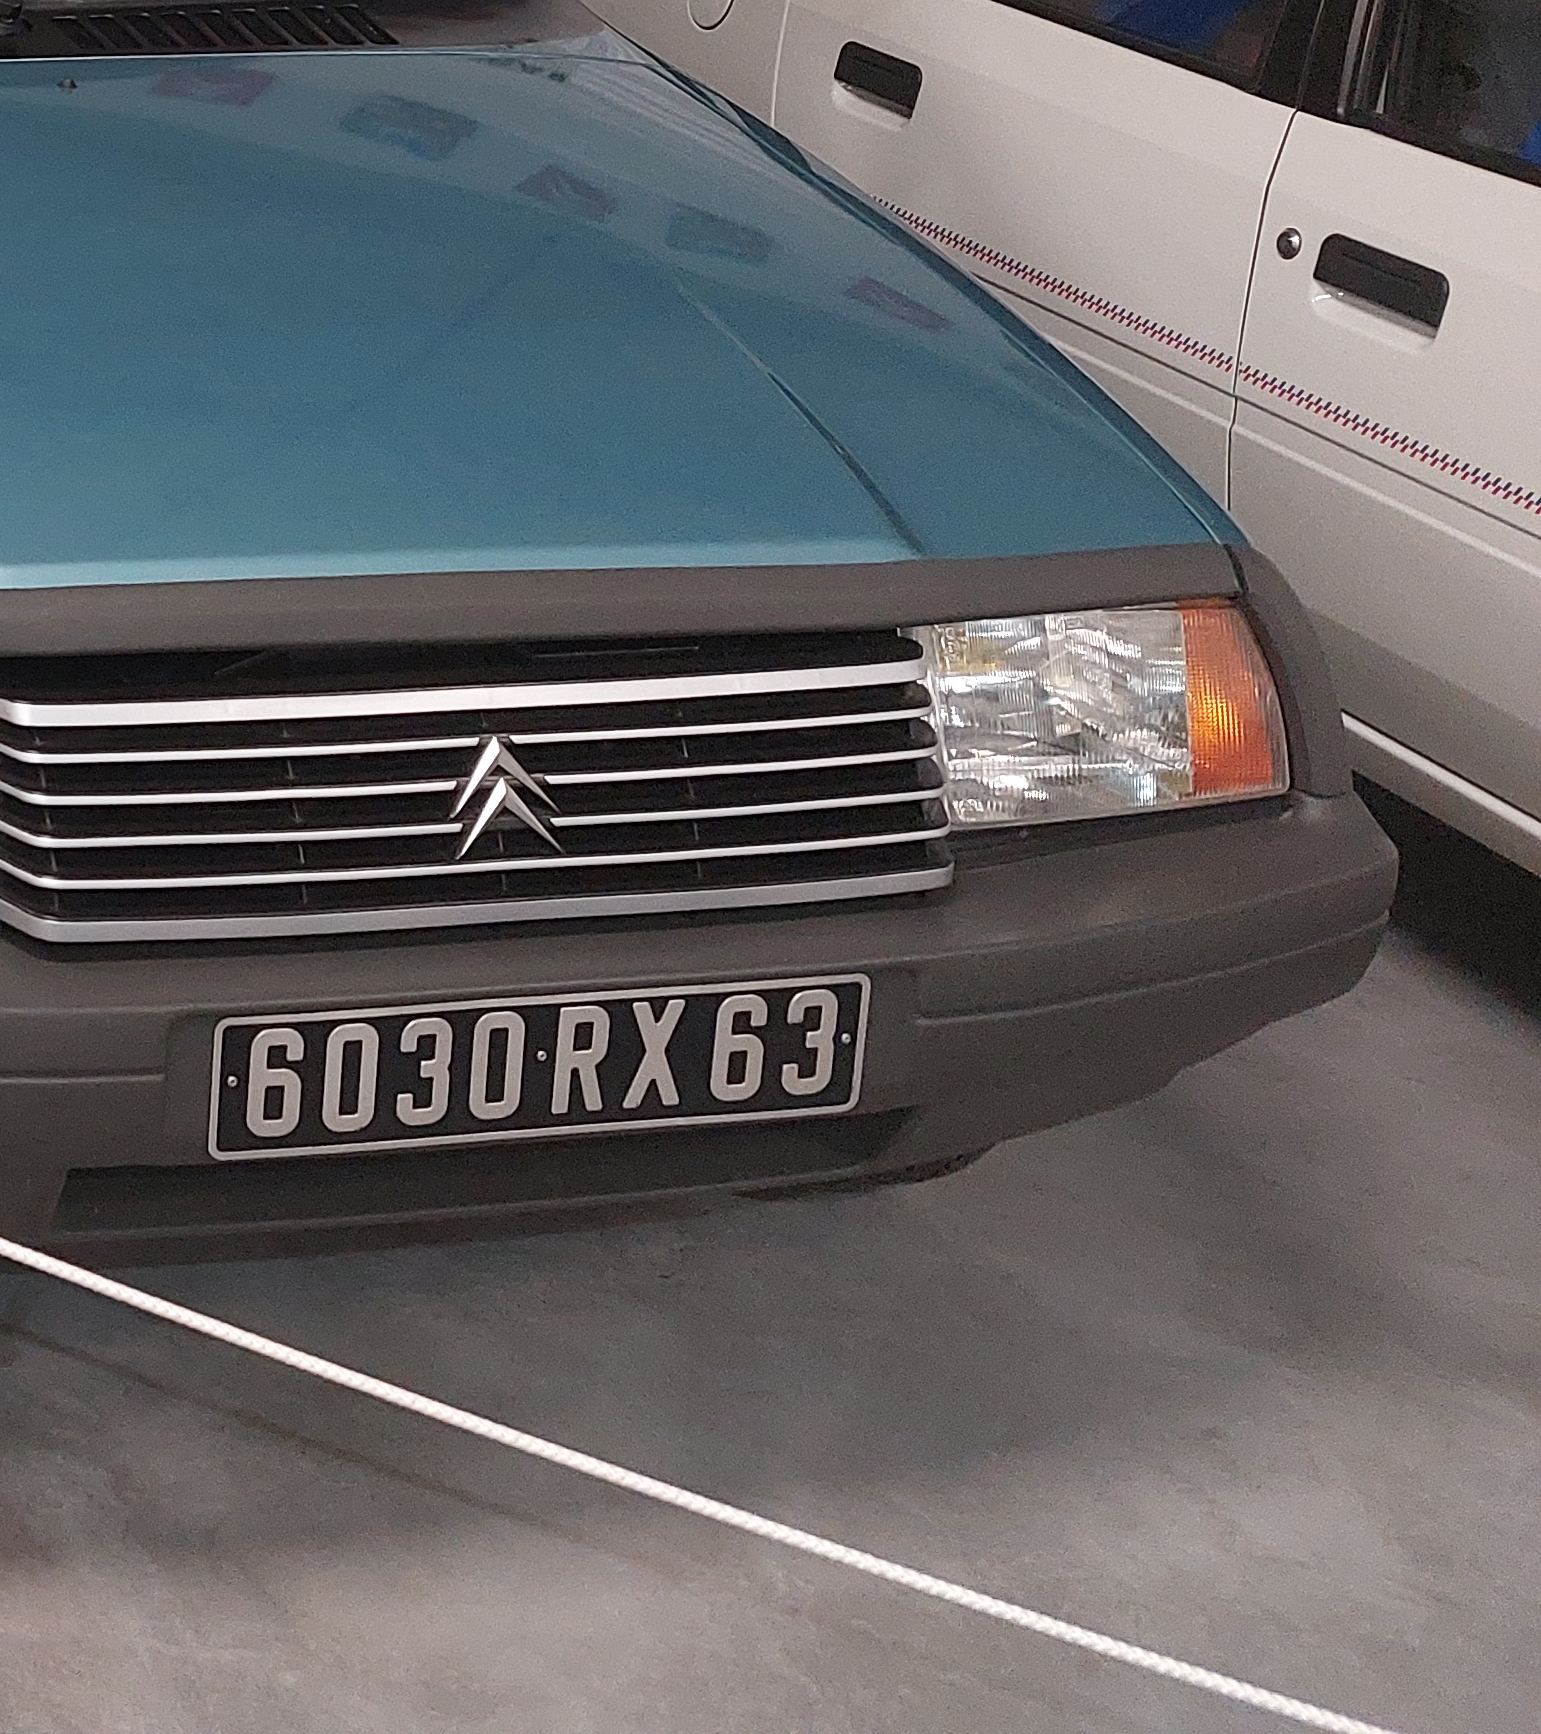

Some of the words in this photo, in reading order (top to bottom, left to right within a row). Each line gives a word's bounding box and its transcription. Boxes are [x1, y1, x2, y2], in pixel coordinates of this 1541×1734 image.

[245, 1010, 526, 1138] 6030
[551, 999, 686, 1115] RX
[709, 989, 839, 1102] 63
